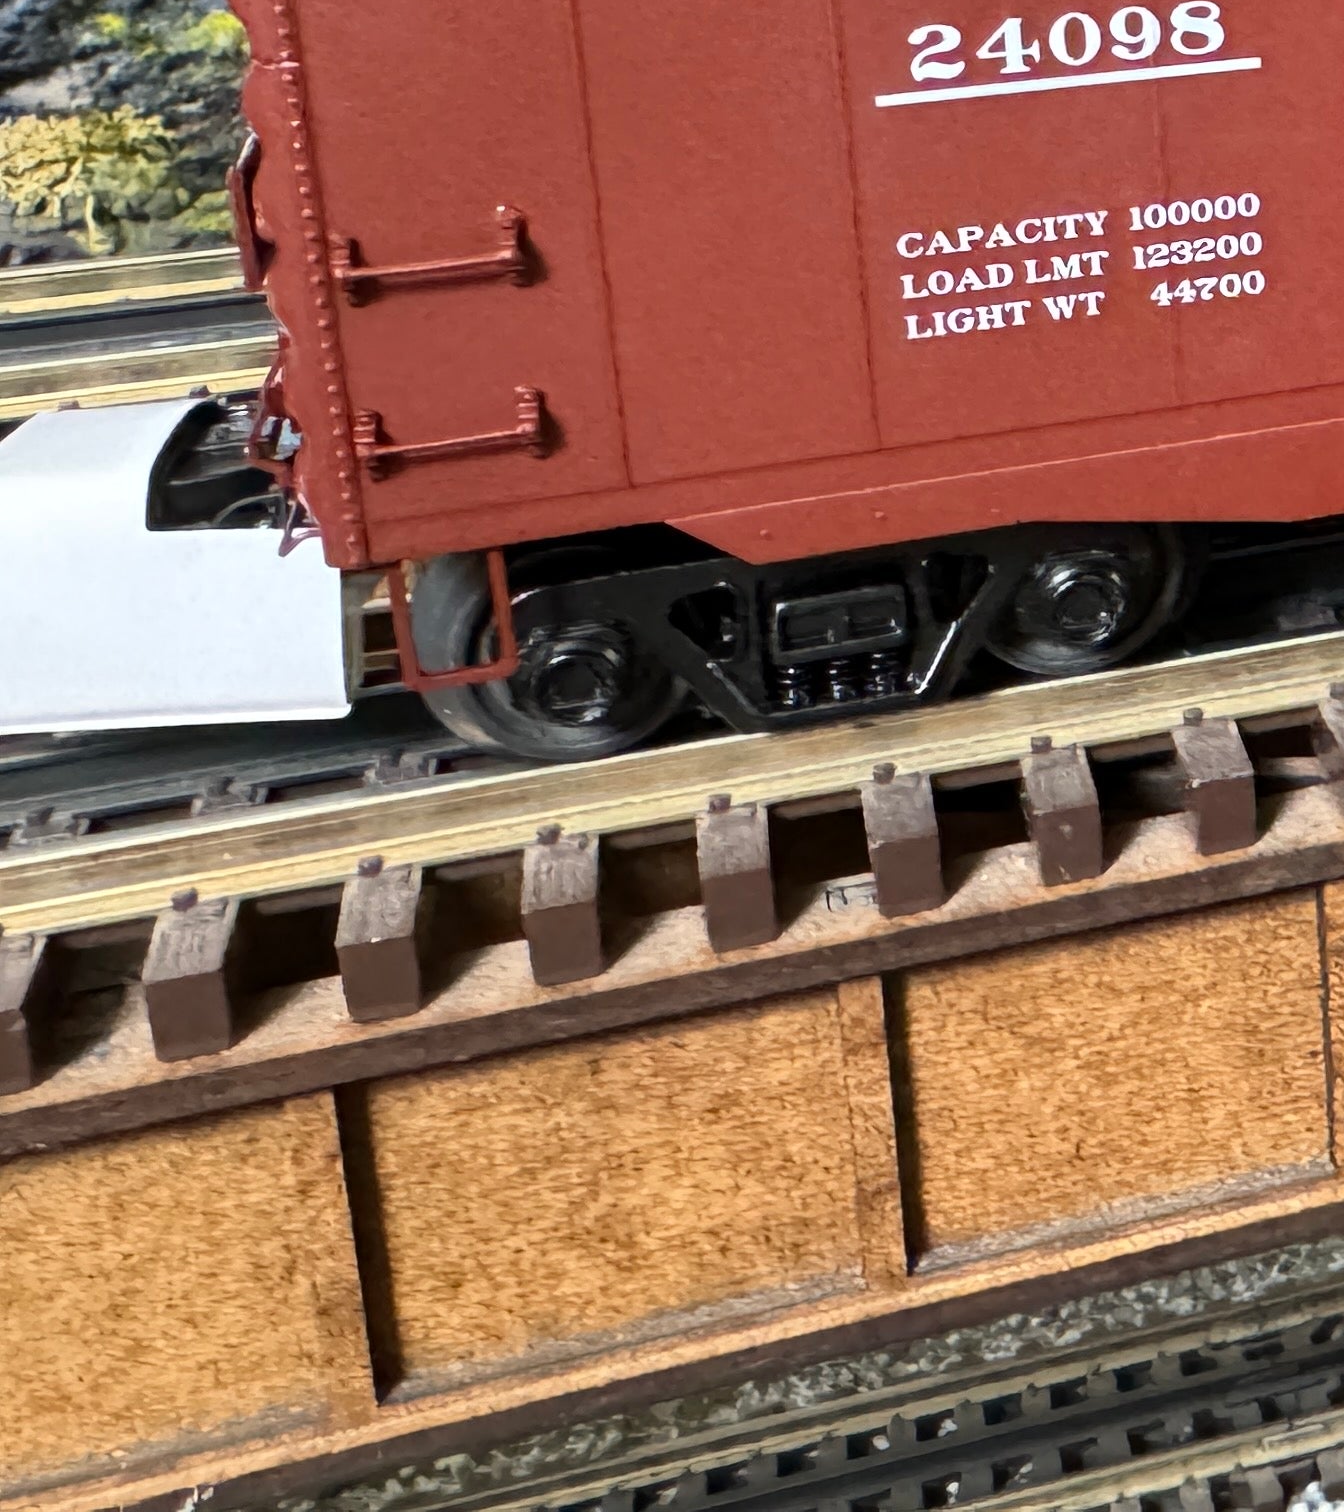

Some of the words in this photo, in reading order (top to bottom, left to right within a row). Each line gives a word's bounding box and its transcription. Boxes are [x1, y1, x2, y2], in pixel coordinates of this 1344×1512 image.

[906, 0, 1226, 83] 24098
[895, 209, 1109, 259] CAPACITY
[1128, 192, 1261, 231] 100000
[899, 263, 1014, 300] LOAD
[1021, 250, 1111, 285] LMT
[1132, 231, 1263, 270] 123200
[903, 300, 1032, 340] LIGHT
[1041, 290, 1106, 321] WT
[1149, 269, 1266, 307] 44700
